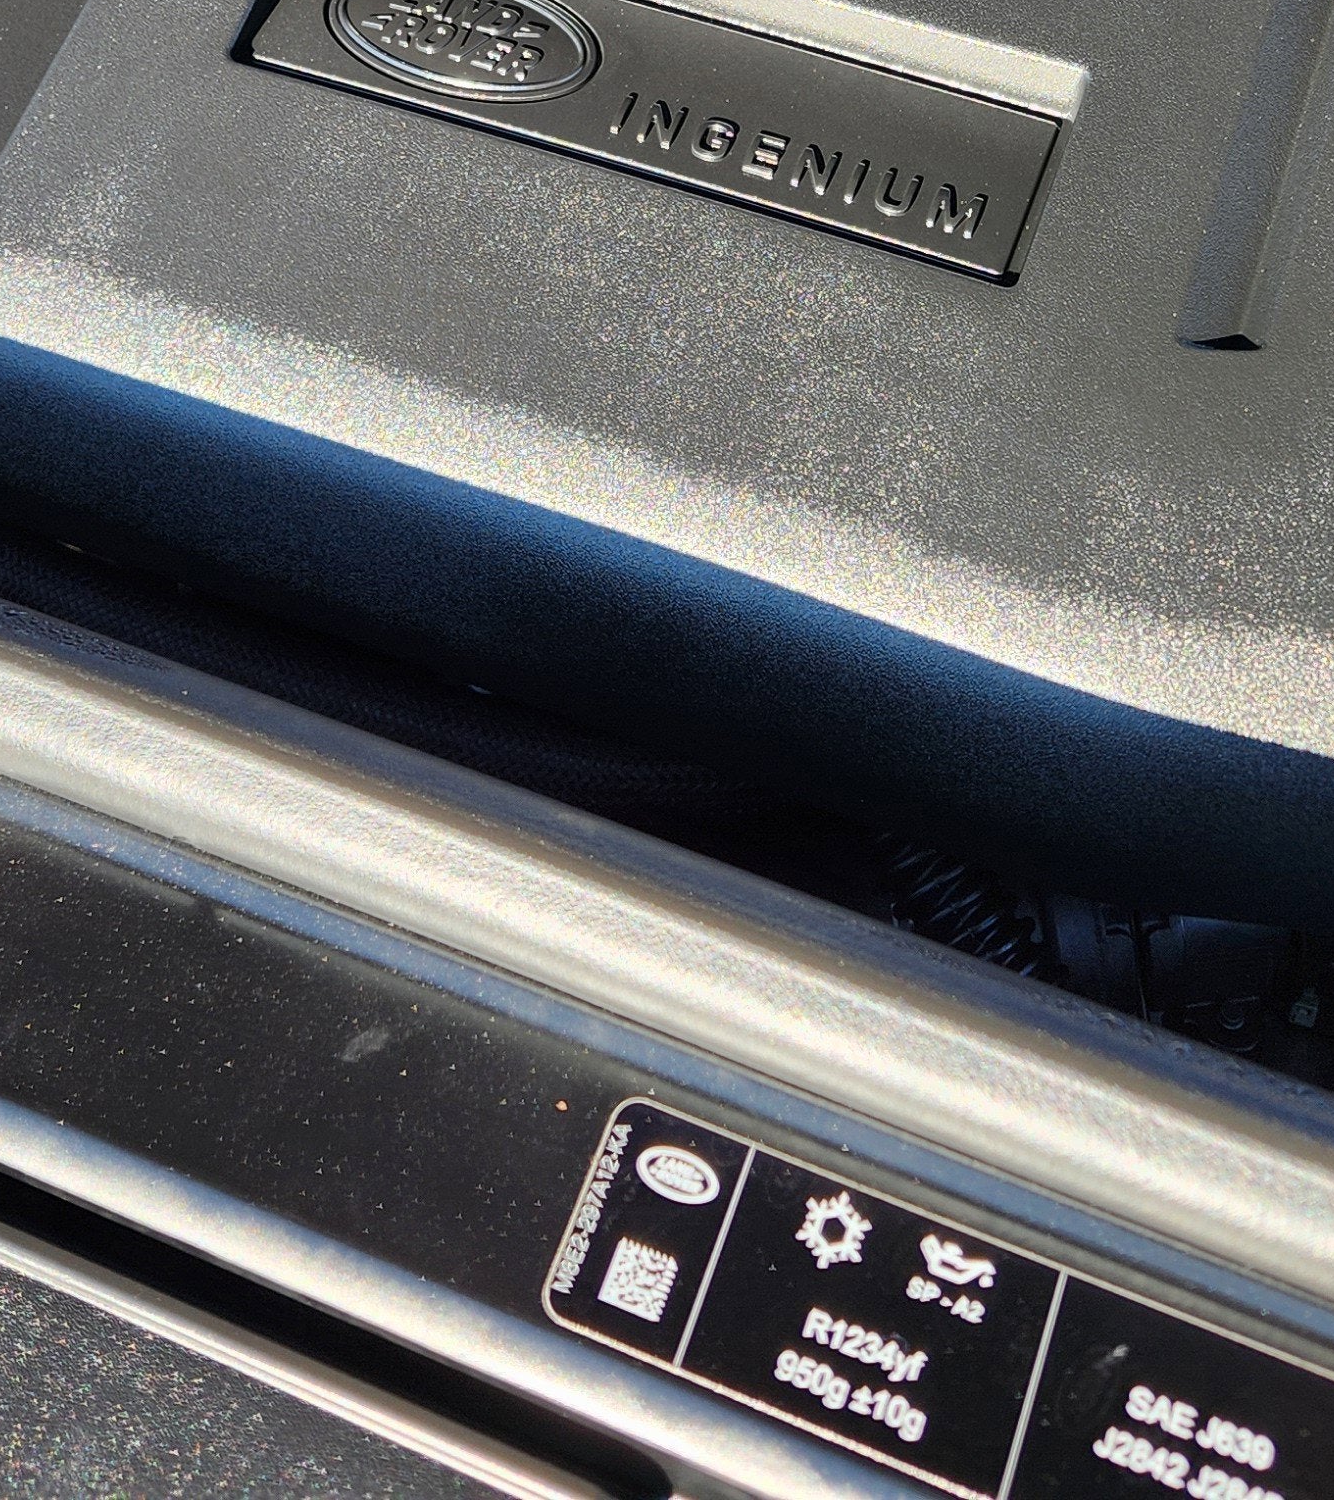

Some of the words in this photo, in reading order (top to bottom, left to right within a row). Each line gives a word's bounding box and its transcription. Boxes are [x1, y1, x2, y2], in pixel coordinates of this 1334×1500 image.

[379, 11, 545, 82] ROVER
[609, 91, 990, 239] INGENIUM
[801, 1306, 929, 1383] R1234yf
[773, 1348, 852, 1411] 950g
[847, 1384, 928, 1443] ±10g
[1124, 1384, 1200, 1441] SAE
[1195, 1415, 1276, 1472] J639
[1091, 1425, 1191, 1490] J2842
